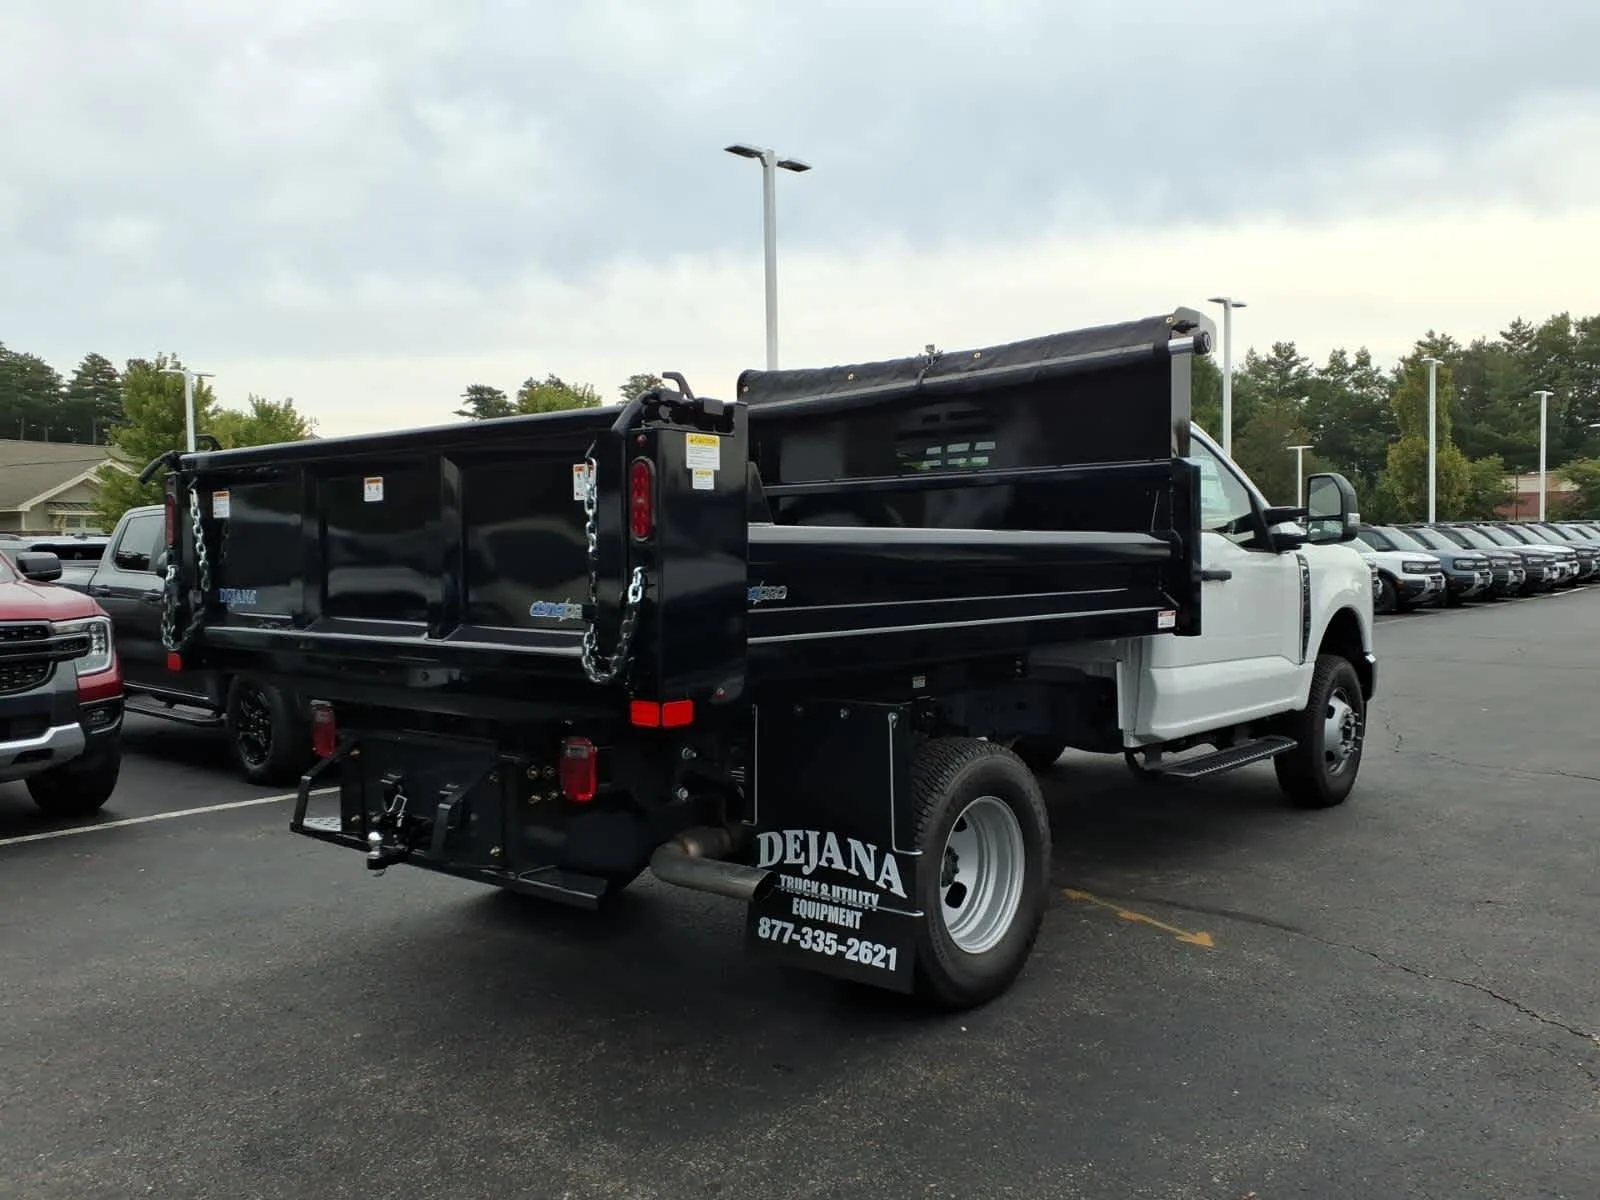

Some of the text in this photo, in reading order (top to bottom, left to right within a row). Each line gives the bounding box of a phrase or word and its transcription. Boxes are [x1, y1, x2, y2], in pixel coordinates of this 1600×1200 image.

[756, 829, 908, 899] DEJANA
[779, 874, 819, 897] TRUCK
[831, 885, 880, 911] UTILITY
[791, 897, 863, 930] EQUIPMENT
[757, 917, 897, 971] 877-335-2621
